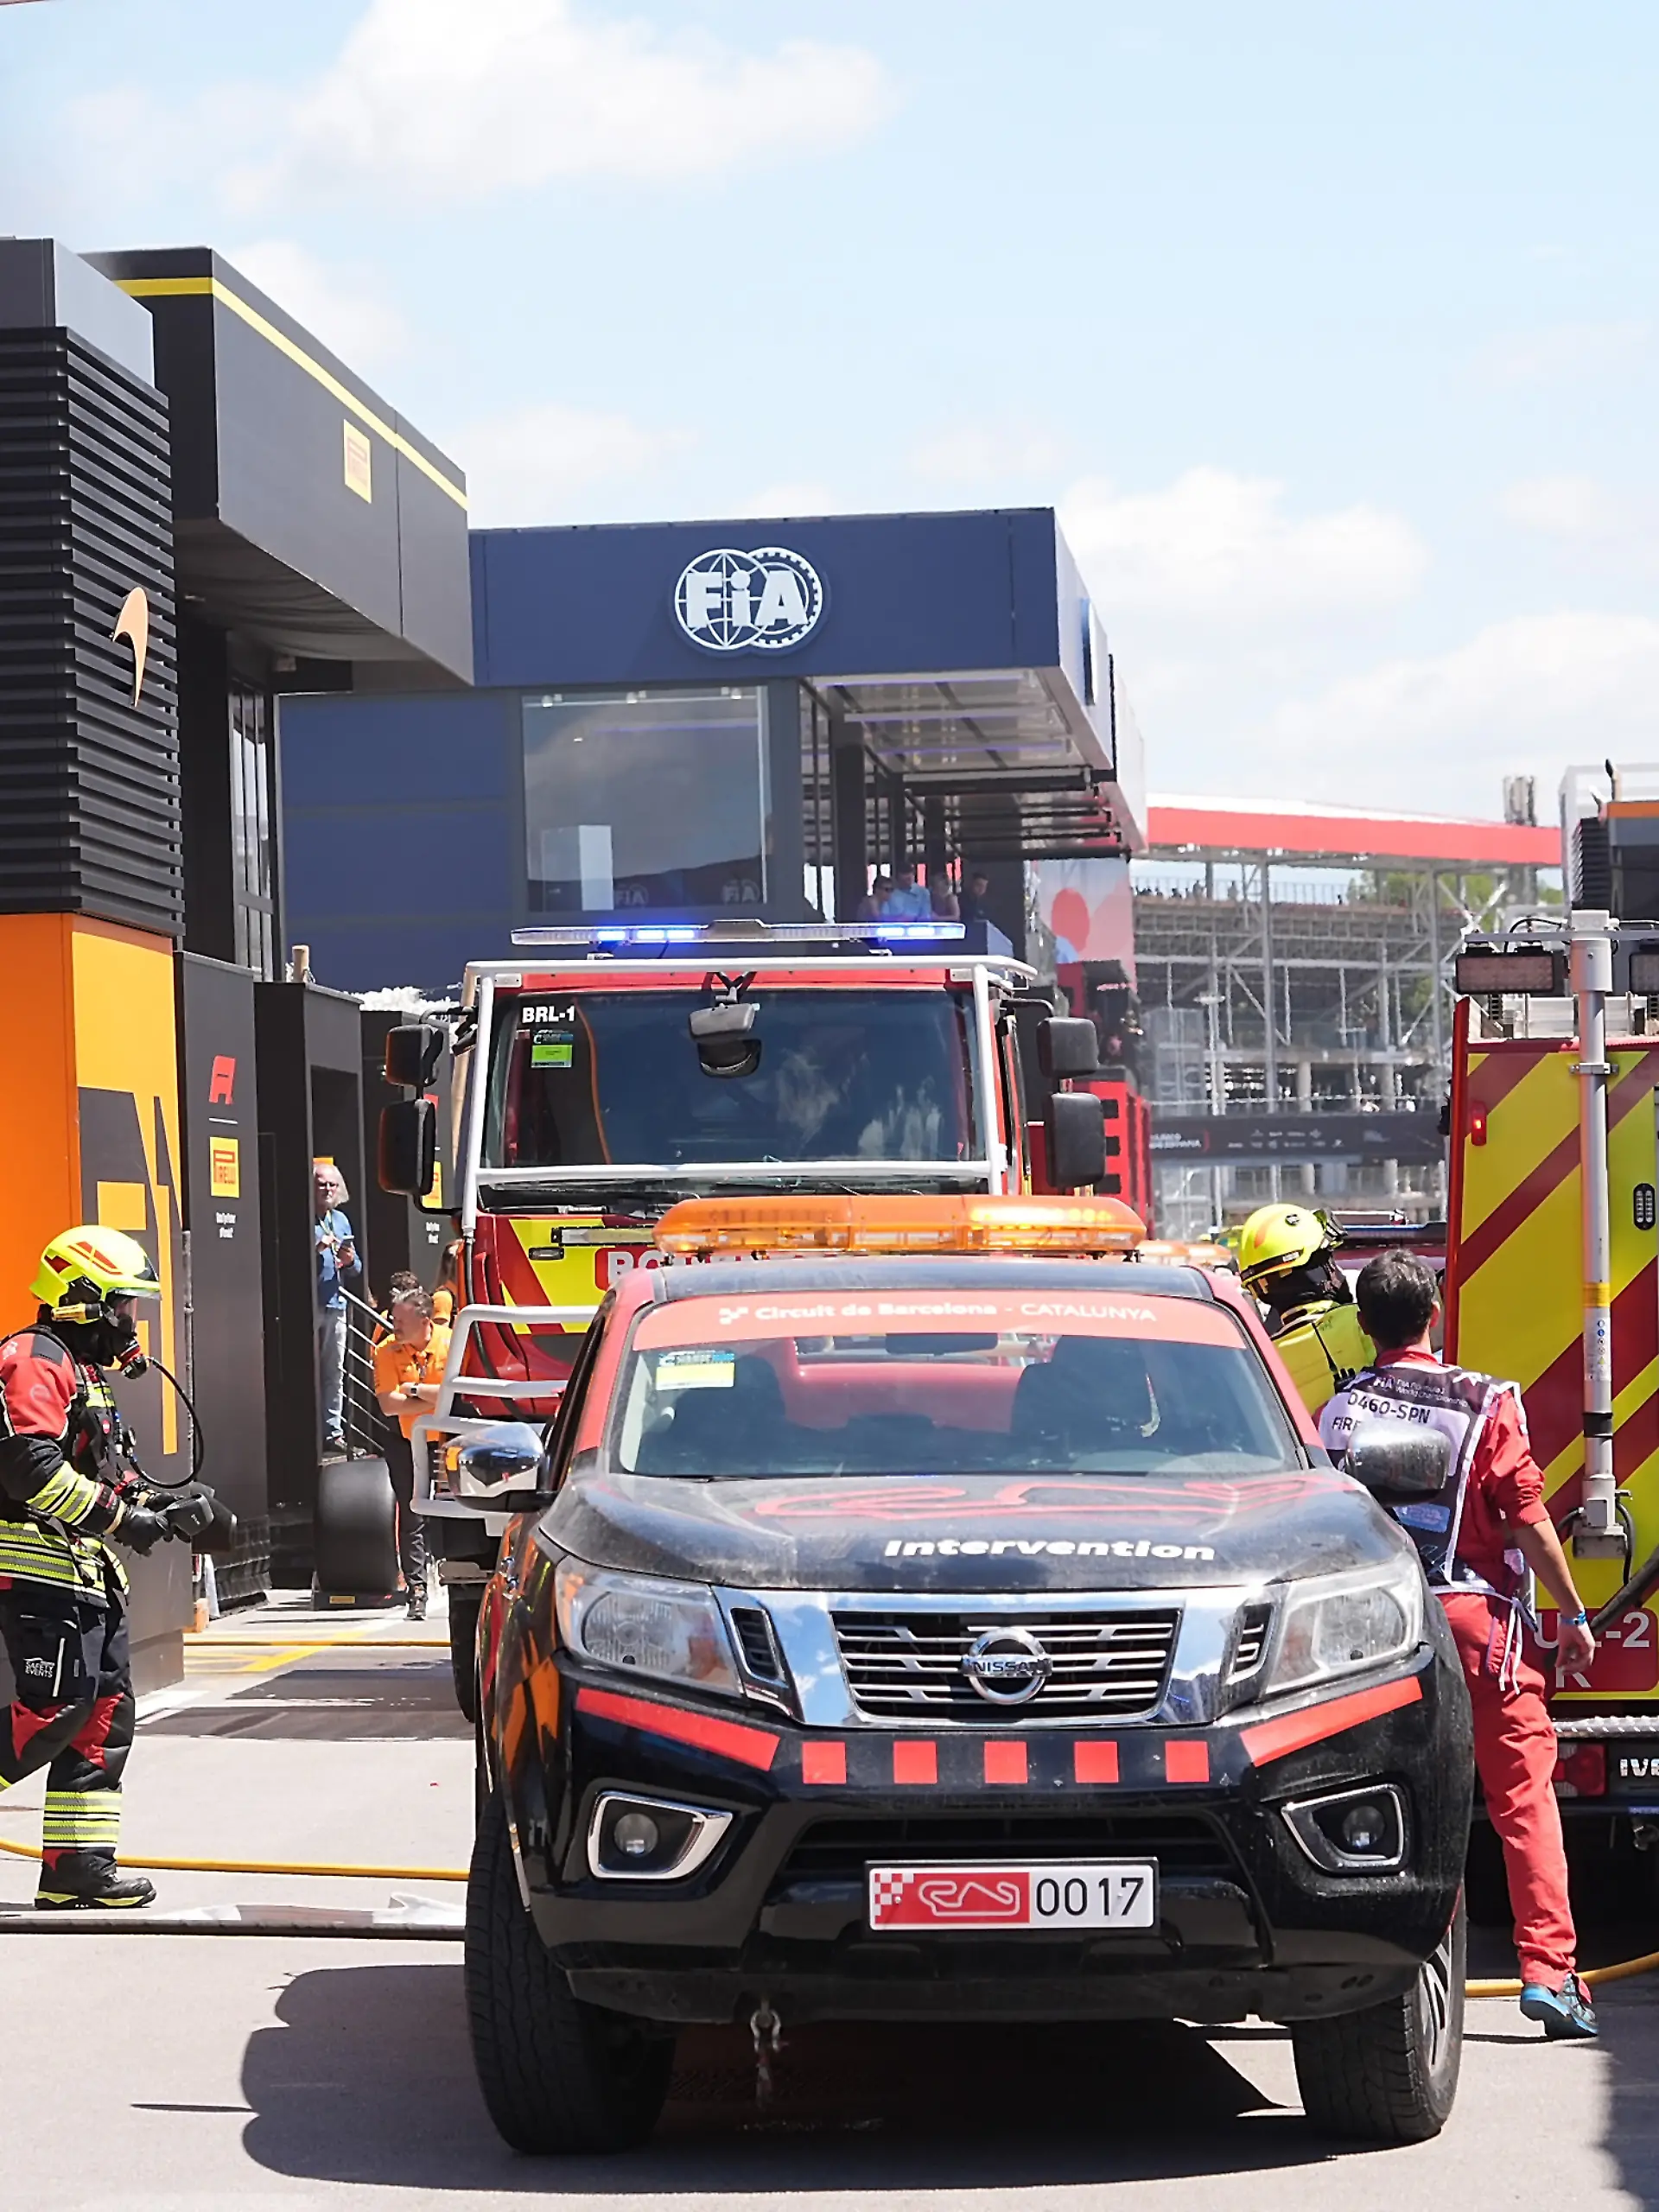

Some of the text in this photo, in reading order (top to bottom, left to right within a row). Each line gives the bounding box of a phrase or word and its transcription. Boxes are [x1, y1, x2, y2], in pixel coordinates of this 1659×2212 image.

[521, 1006, 575, 1023] BRL-1
[754, 1306, 835, 1320] Circuit
[841, 1304, 871, 1316] de
[878, 1303, 997, 1315] Barcelona
[1020, 1303, 1156, 1321] CATALUNYA
[884, 1540, 1216, 1560] Intervention
[973, 1661, 1043, 1674] NISSAN
[1036, 1877, 1145, 1916] 0017
